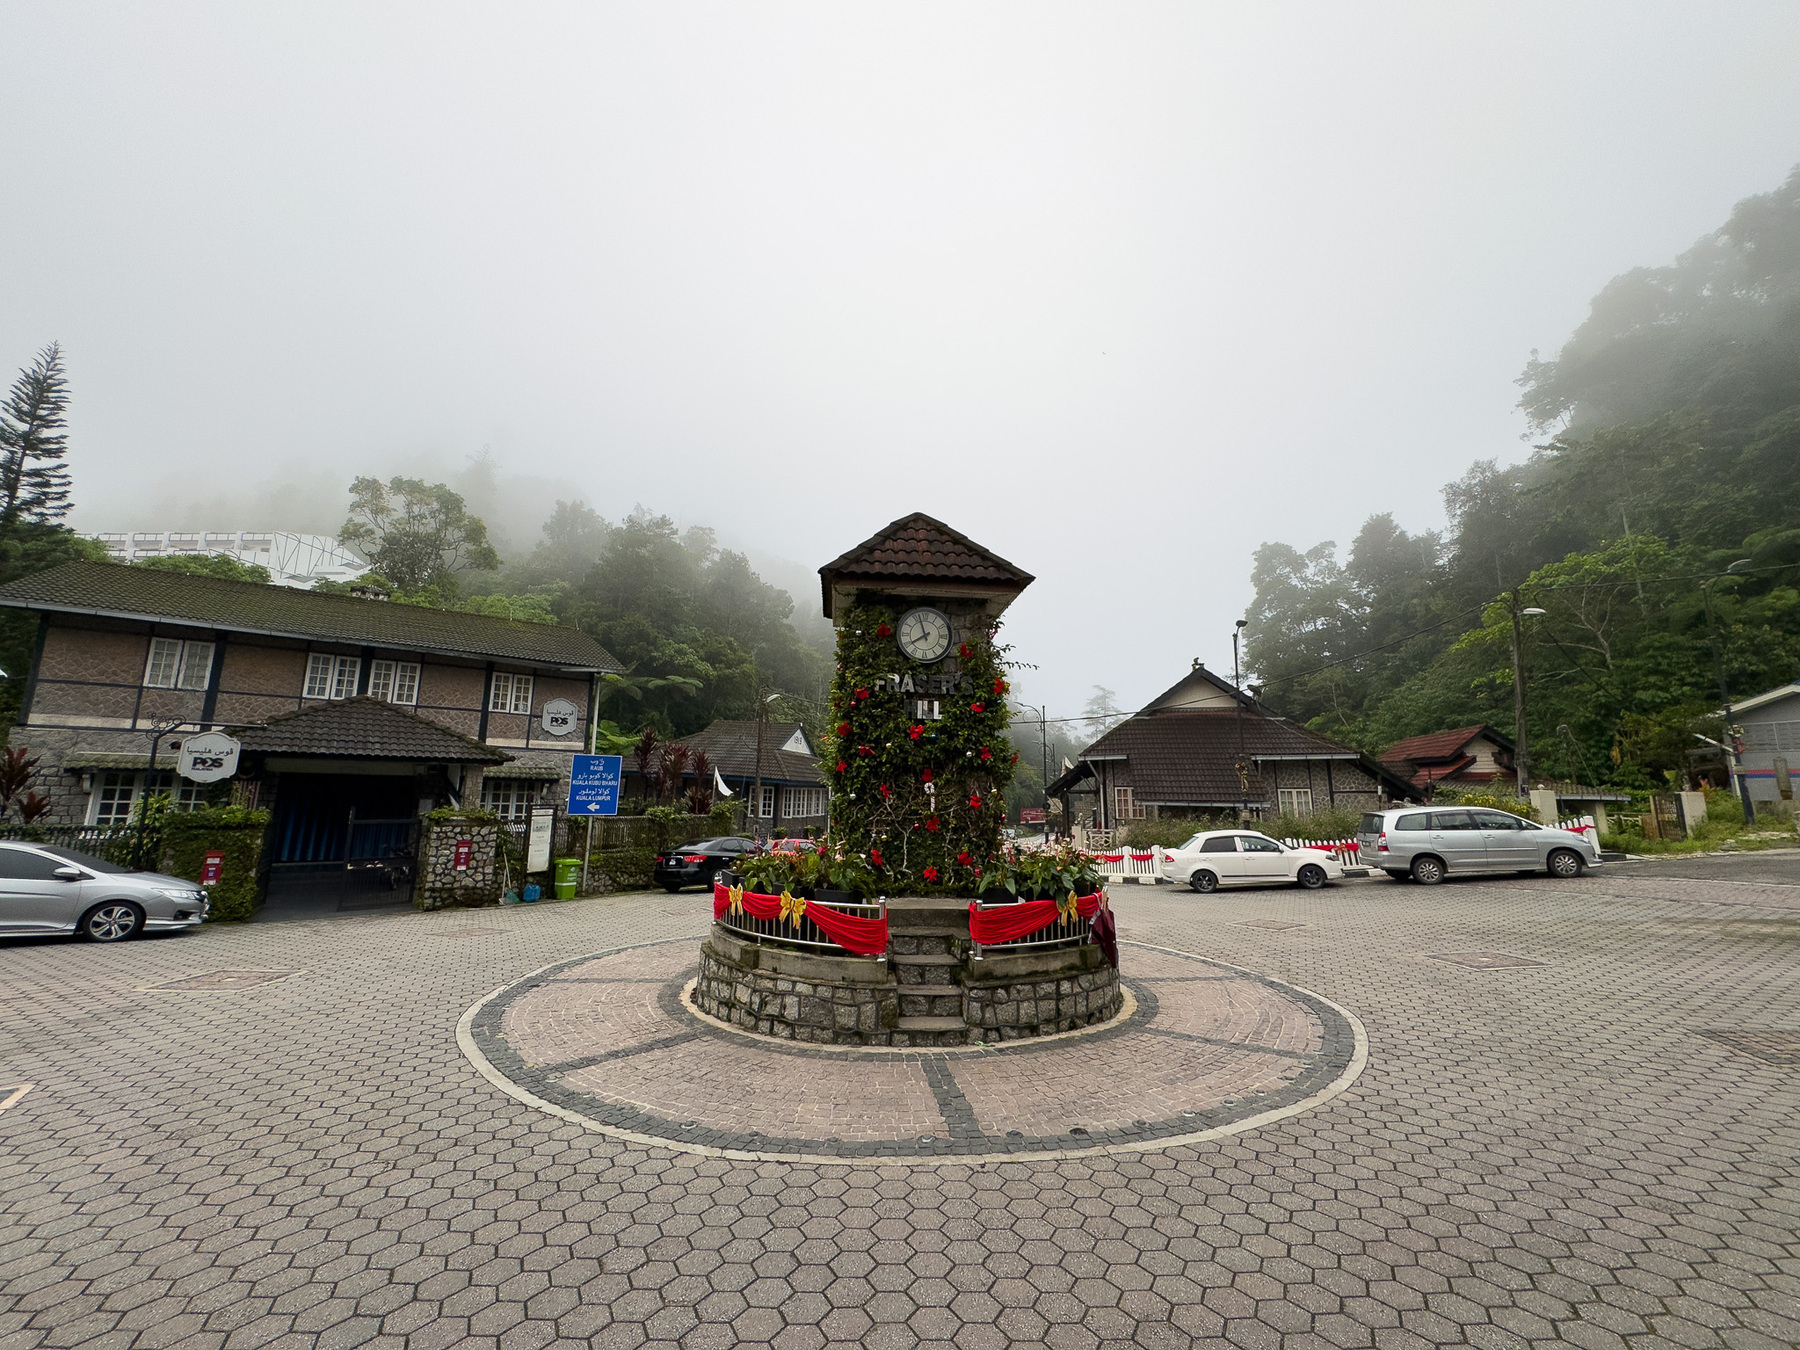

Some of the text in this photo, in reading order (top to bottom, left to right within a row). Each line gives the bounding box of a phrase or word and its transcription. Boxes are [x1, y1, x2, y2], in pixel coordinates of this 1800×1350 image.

[874, 671, 974, 695] FRASER'S
[904, 700, 943, 719] HILL
[550, 716, 568, 725] POS
[192, 756, 224, 768] POS
